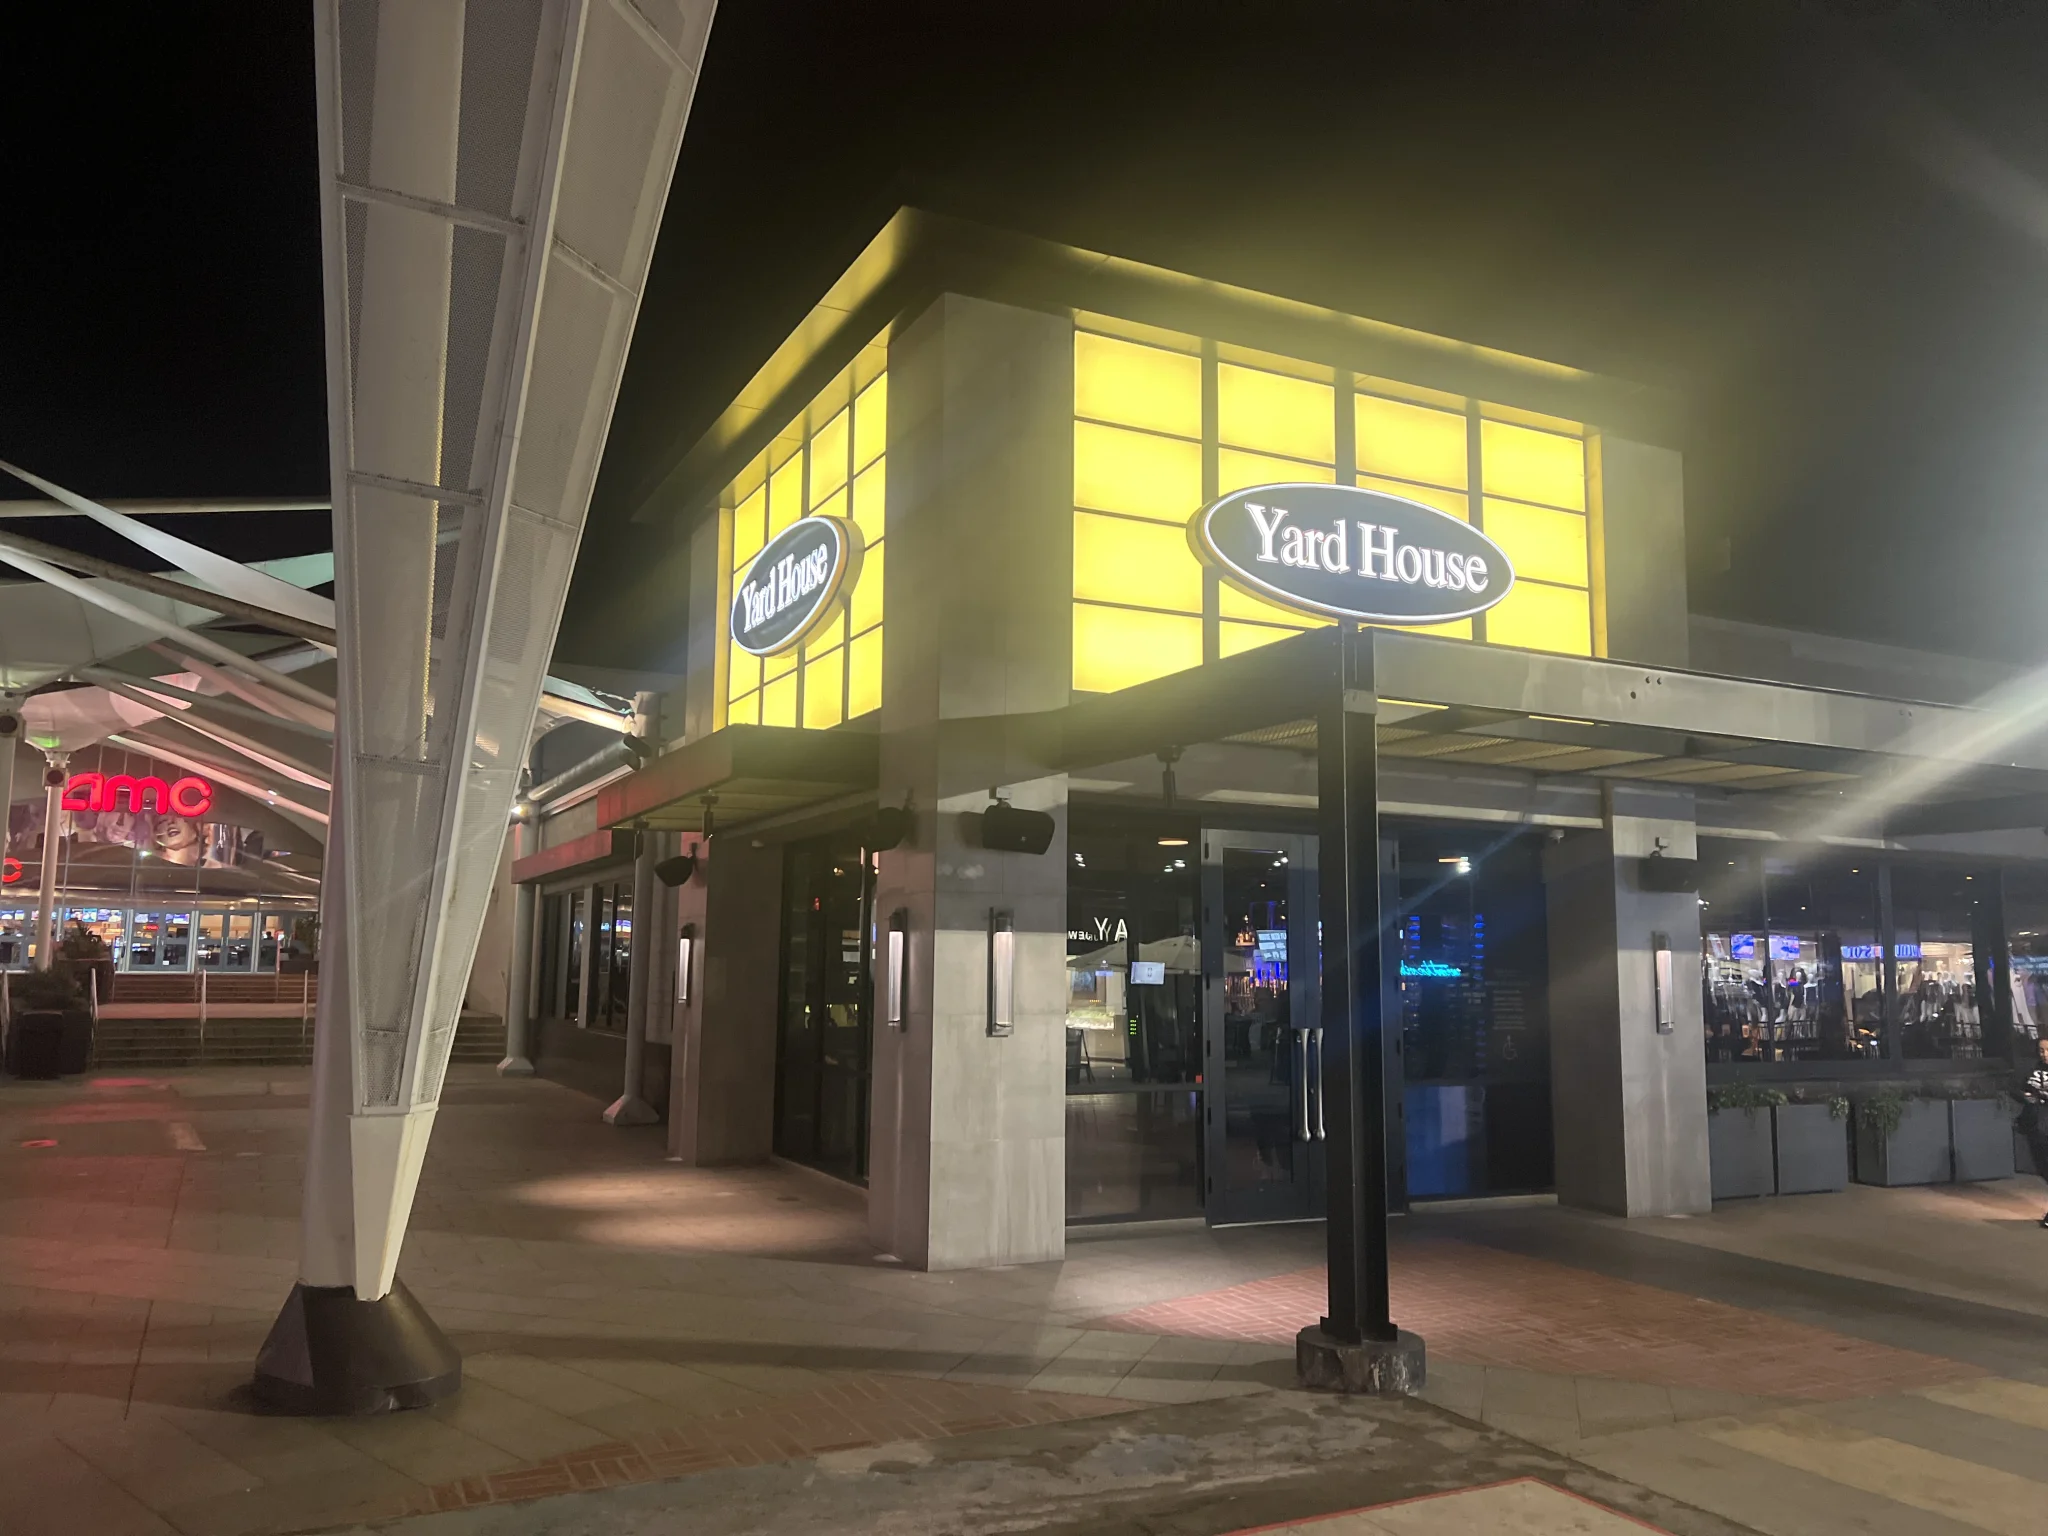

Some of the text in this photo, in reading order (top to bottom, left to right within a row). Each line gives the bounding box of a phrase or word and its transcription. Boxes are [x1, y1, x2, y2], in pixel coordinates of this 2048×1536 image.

[742, 543, 828, 633] Yard House
[1244, 500, 1490, 594] Yard House
